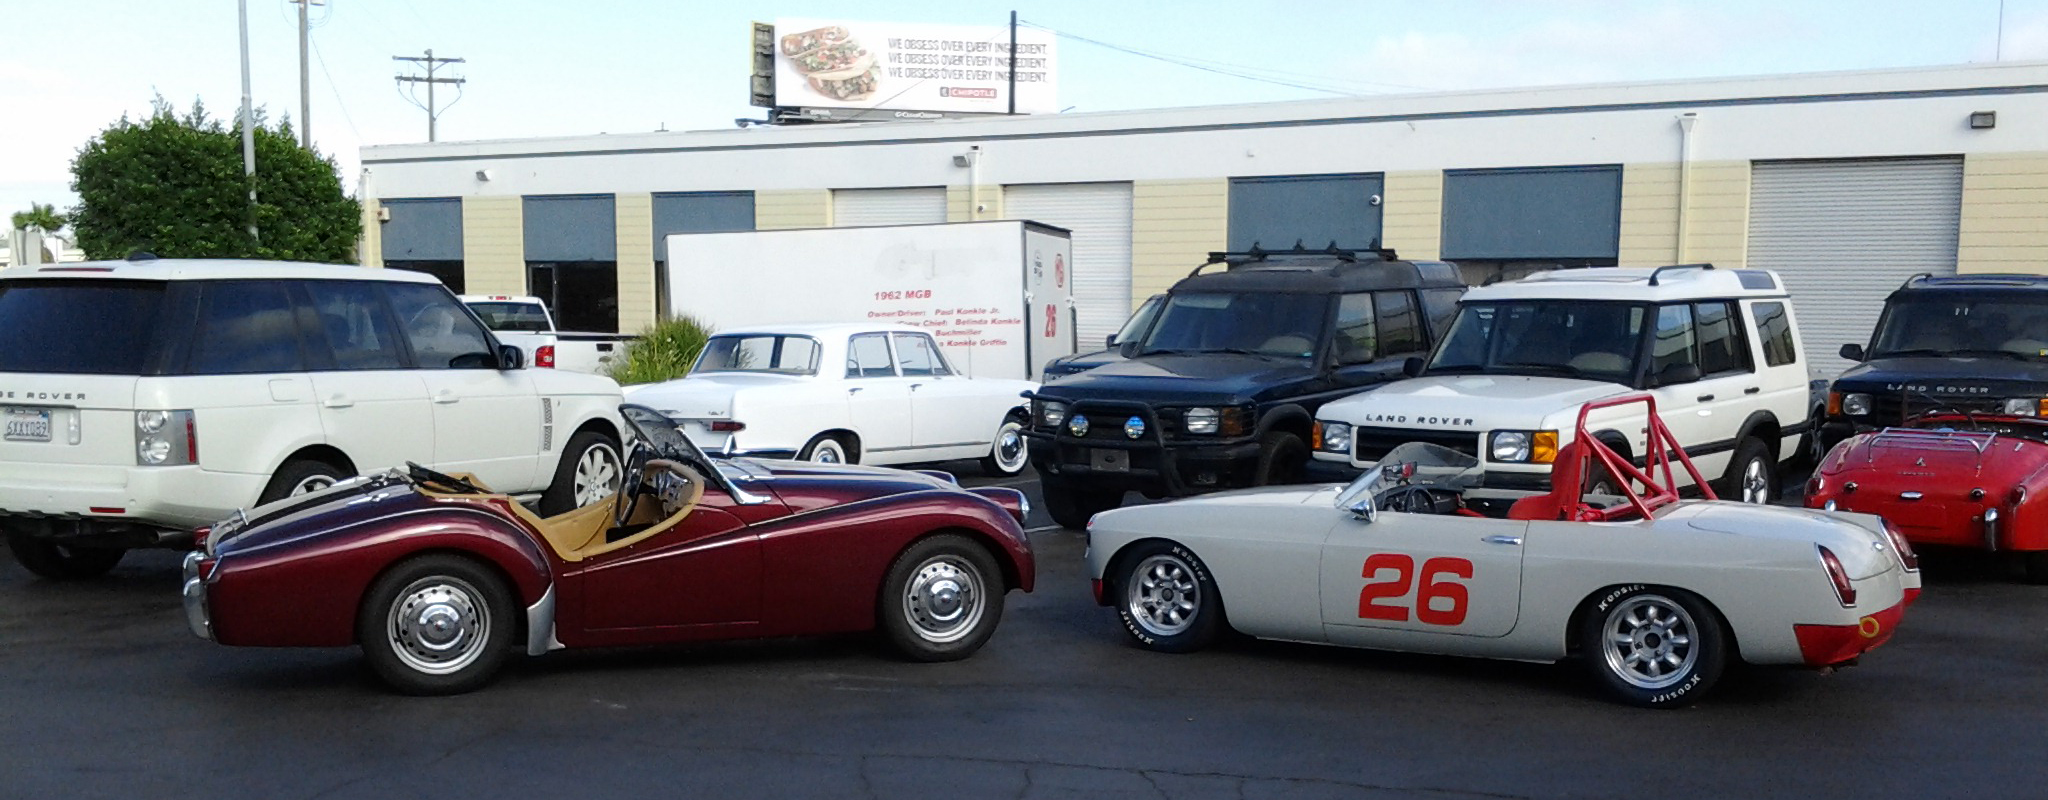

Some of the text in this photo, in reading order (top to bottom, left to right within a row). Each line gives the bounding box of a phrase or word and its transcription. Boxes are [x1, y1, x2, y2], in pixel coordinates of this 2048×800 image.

[888, 38, 1048, 54] WE OBSESS OVER EVERY INGEDIENT.
[888, 53, 902, 64] WE
[904, 54, 939, 65] OBSESS
[941, 55, 964, 66] OVER
[965, 56, 992, 67] EVERY
[888, 67, 902, 78] WE
[904, 68, 939, 79] OBSESS
[941, 68, 964, 80] OVER
[965, 70, 992, 81] EVERY
[951, 88, 996, 98] CHIPOTLE
[874, 290, 932, 300] 1962 MGB
[1045, 304, 1056, 337] 26
[26, 392, 86, 400] ROVER
[1936, 386, 1989, 394] ROVER
[1365, 413, 1475, 427] LAND ROVER
[1358, 553, 1473, 627] 26
